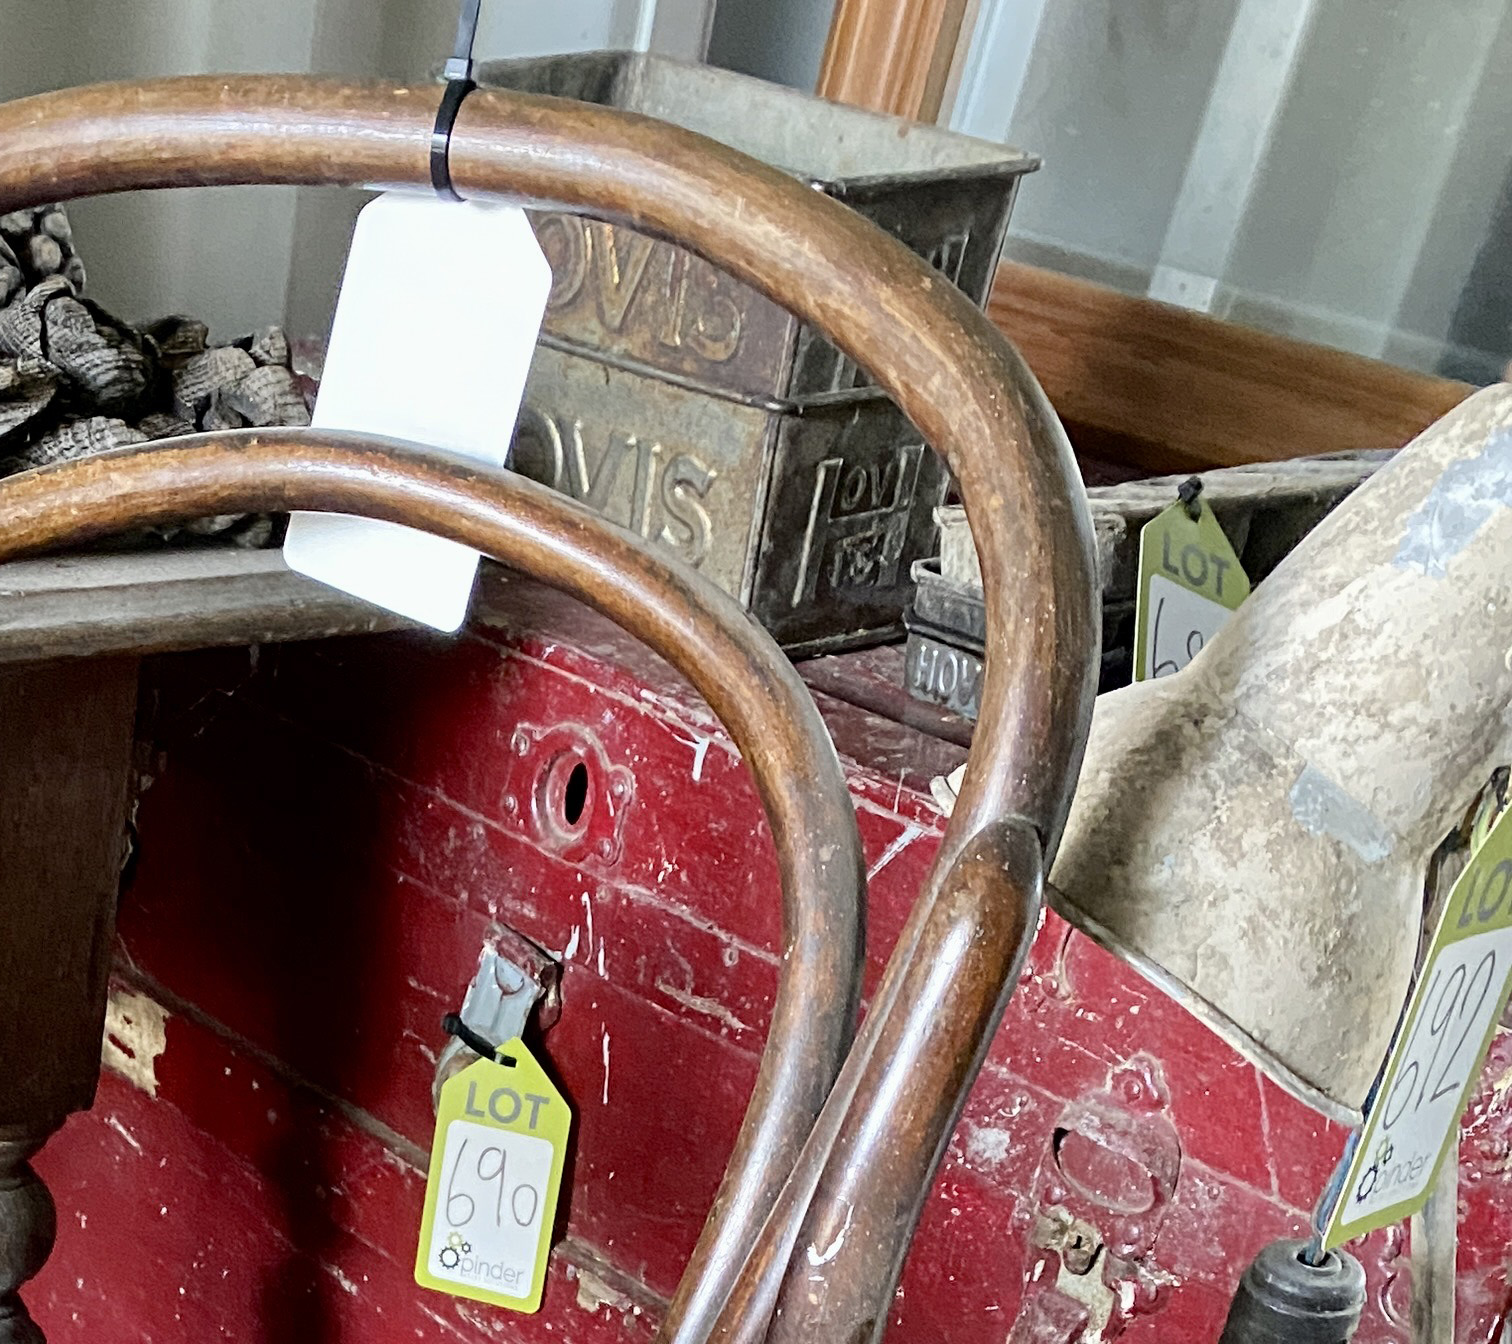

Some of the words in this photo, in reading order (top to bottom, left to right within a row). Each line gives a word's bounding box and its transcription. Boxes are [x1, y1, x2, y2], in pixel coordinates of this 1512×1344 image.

[1162, 530, 1232, 598] LOT
[1456, 856, 1512, 930] LO
[1384, 948, 1497, 1131] 692
[464, 1080, 551, 1130] LOT
[445, 1137, 538, 1228] 690
[460, 1254, 525, 1285] pinder
